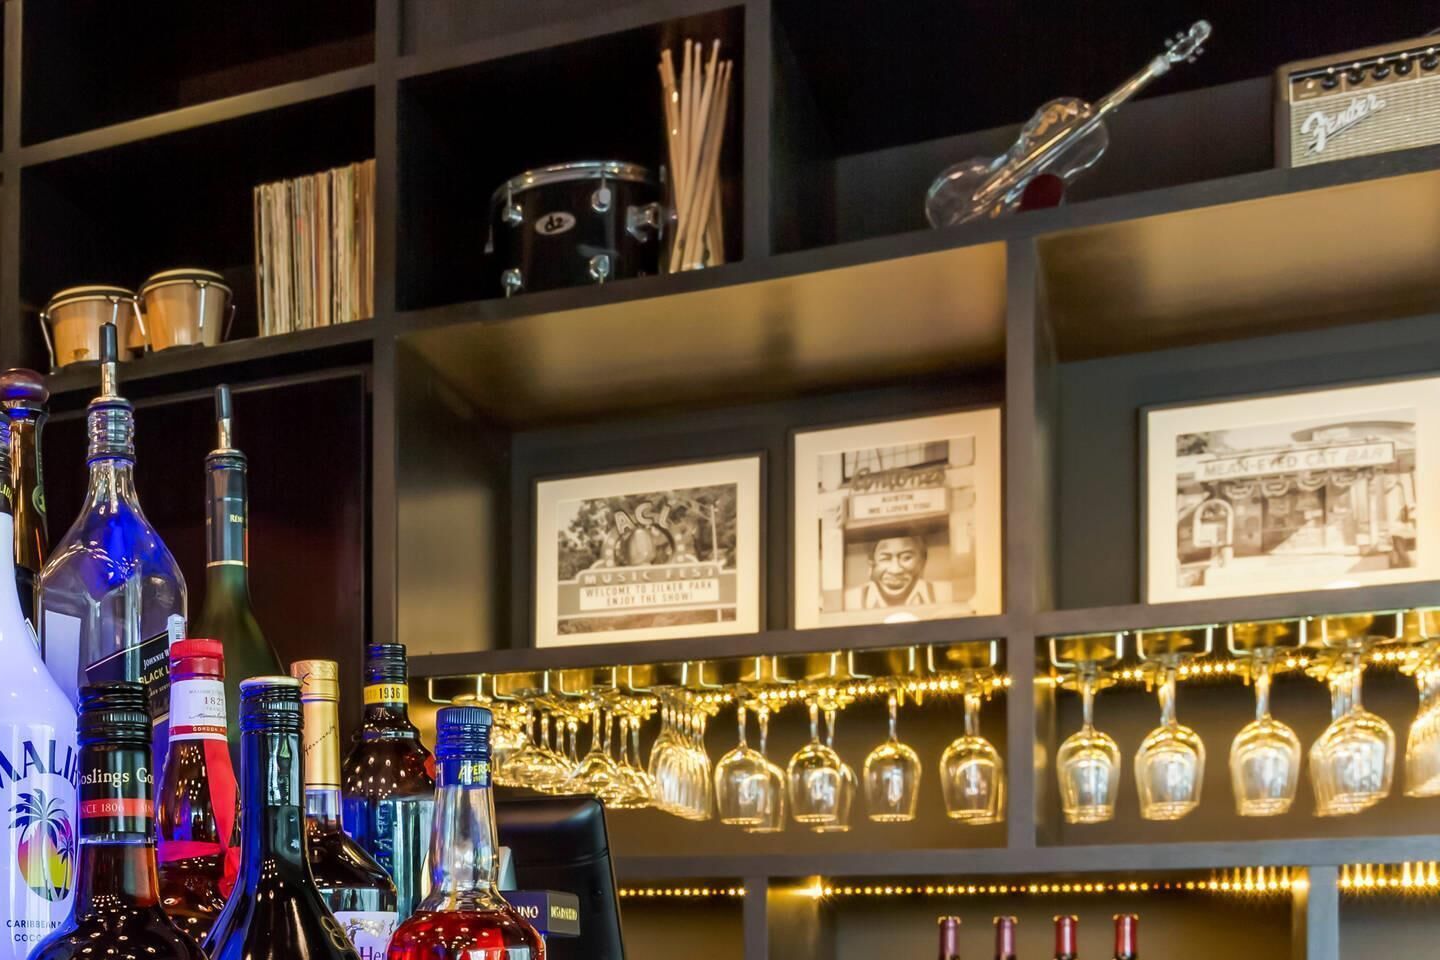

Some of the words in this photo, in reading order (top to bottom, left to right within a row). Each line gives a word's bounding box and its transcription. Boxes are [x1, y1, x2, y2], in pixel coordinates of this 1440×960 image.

[1300, 93, 1386, 155] Fender
[1304, 450, 1339, 466] CAT
[1346, 447, 1385, 462] BAR
[614, 501, 671, 538] ACL
[584, 571, 650, 585] MUSIC
[666, 566, 714, 579] FEST
[585, 586, 631, 598] WELCOME
[636, 585, 647, 593] TO
[651, 583, 683, 593] ZILKER
[689, 581, 712, 590] PARK
[607, 596, 636, 606] ENJOY
[641, 595, 658, 603] THE
[379, 687, 401, 699] 1936
[79, 768, 130, 788] oslings
[6, 919, 56, 929] CARIBBEAN
[14, 933, 41, 942] COCO
